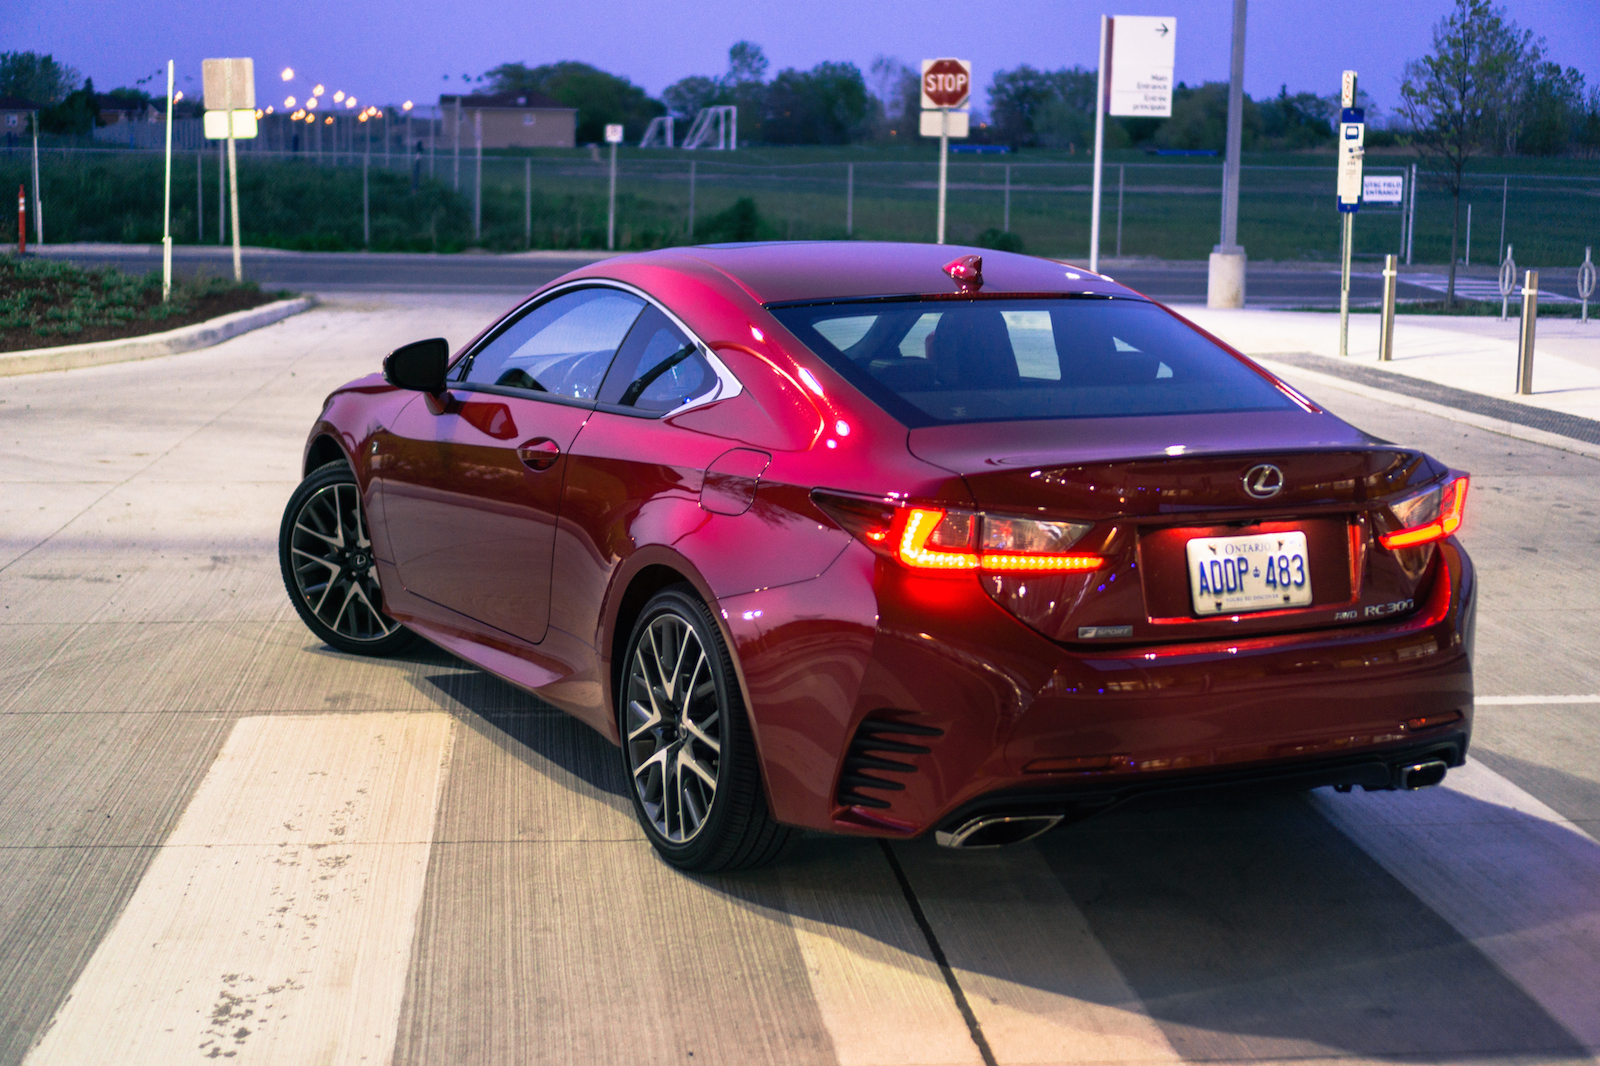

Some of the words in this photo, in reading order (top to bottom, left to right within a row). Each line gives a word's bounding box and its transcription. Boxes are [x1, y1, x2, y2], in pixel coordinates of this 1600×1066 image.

[926, 73, 967, 92] STOP
[1199, 556, 1249, 596] ADDP
[1266, 554, 1305, 588] 483
[1334, 610, 1358, 620] AWD
[1364, 604, 1385, 616] RC
[1386, 599, 1414, 613] 300
